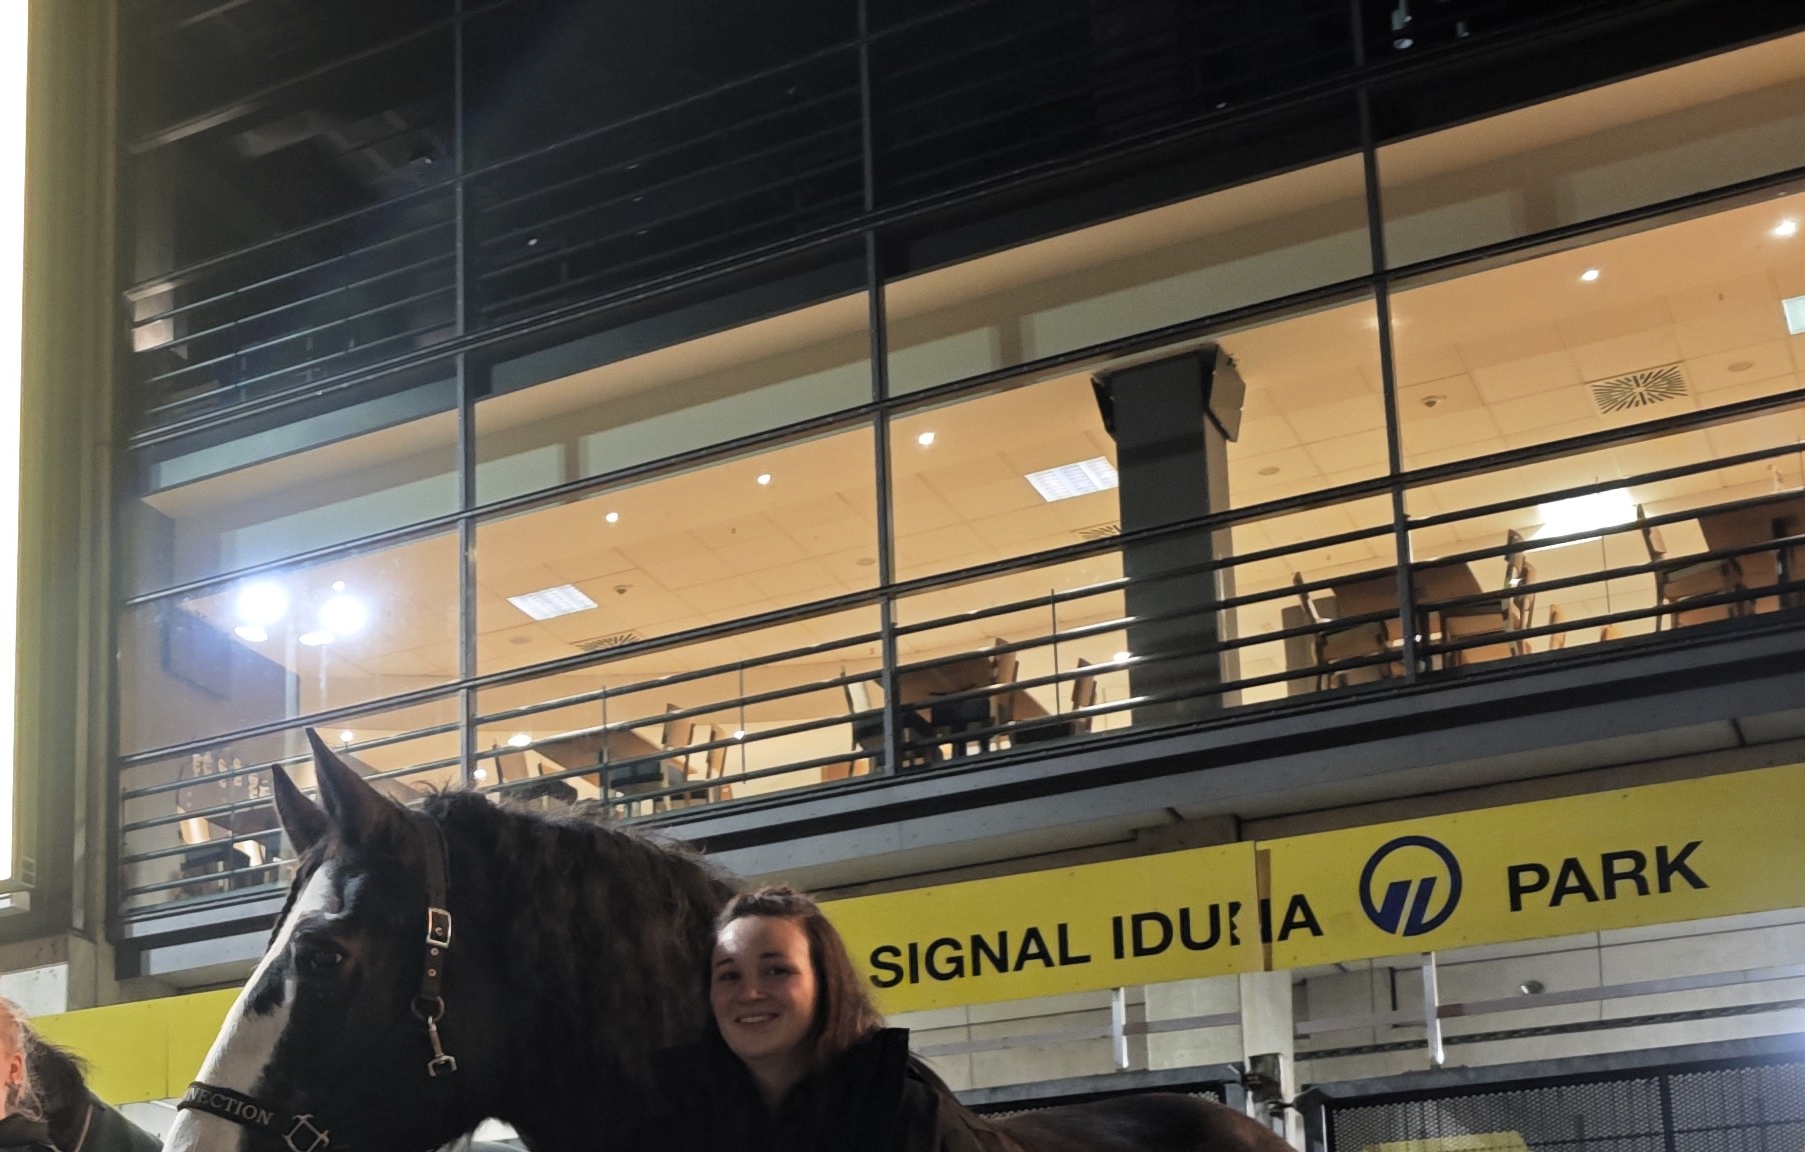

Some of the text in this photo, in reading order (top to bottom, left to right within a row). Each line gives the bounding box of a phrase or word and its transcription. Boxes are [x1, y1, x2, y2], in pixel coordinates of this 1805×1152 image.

[869, 922, 1092, 988] SIGNAL
[1506, 840, 1710, 912] PARK
[185, 1087, 274, 1126] NECTION
